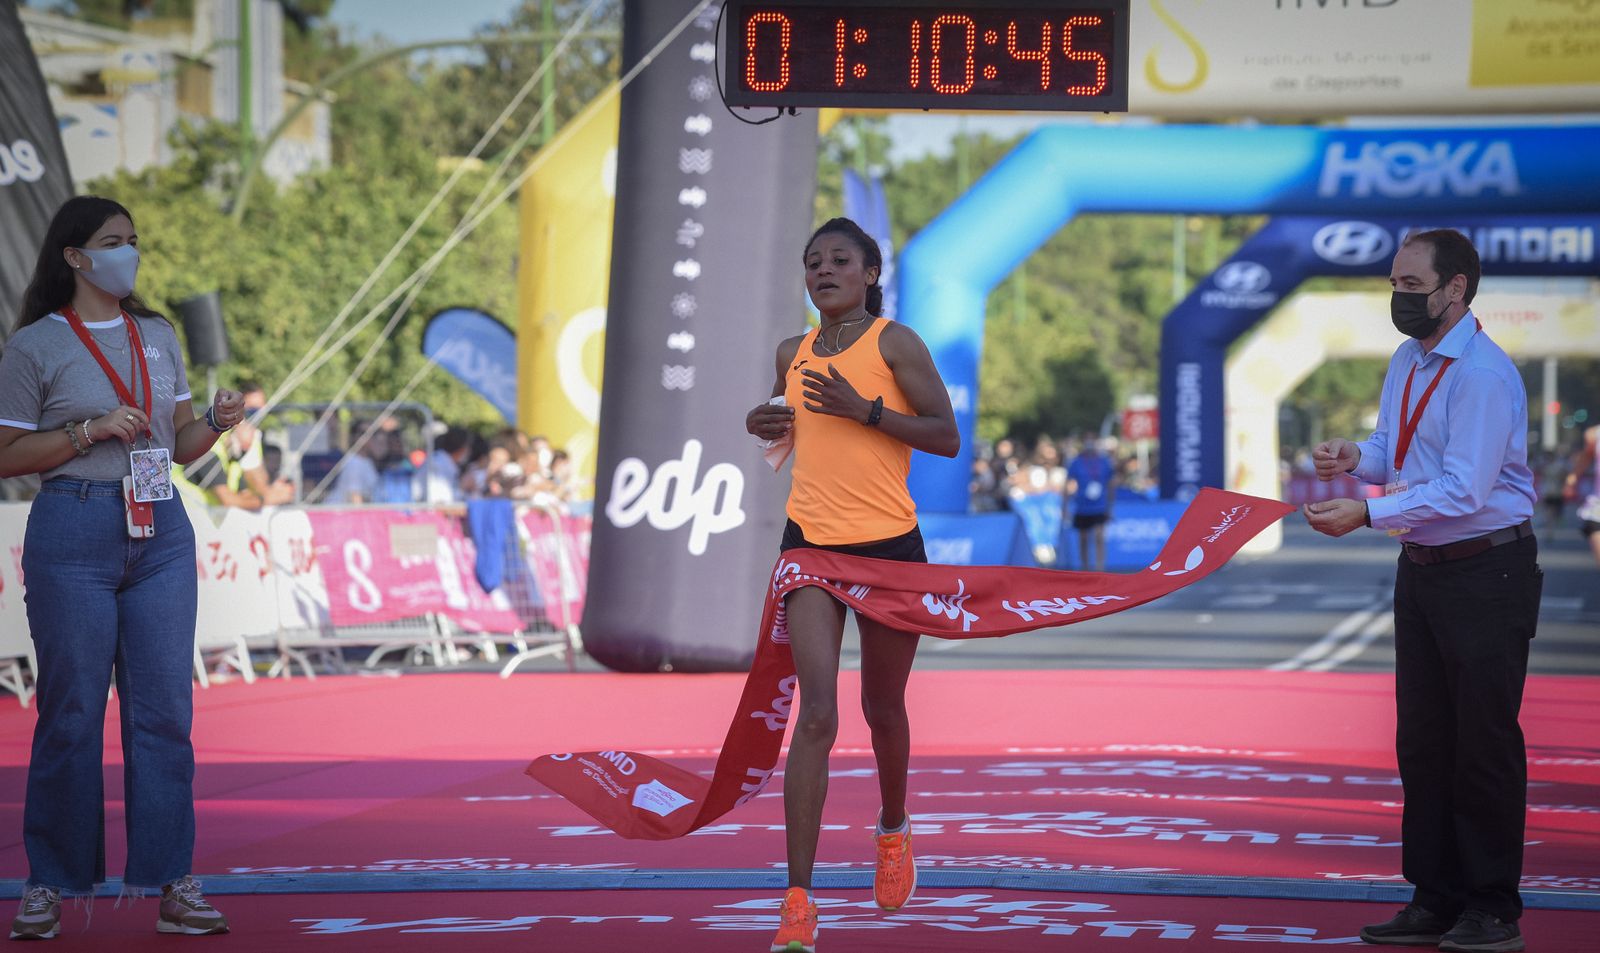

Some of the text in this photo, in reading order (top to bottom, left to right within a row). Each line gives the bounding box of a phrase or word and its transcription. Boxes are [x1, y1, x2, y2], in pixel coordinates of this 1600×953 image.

[1318, 141, 1524, 197] HOKA
[605, 439, 746, 556] edp
[751, 674, 798, 731] edp
